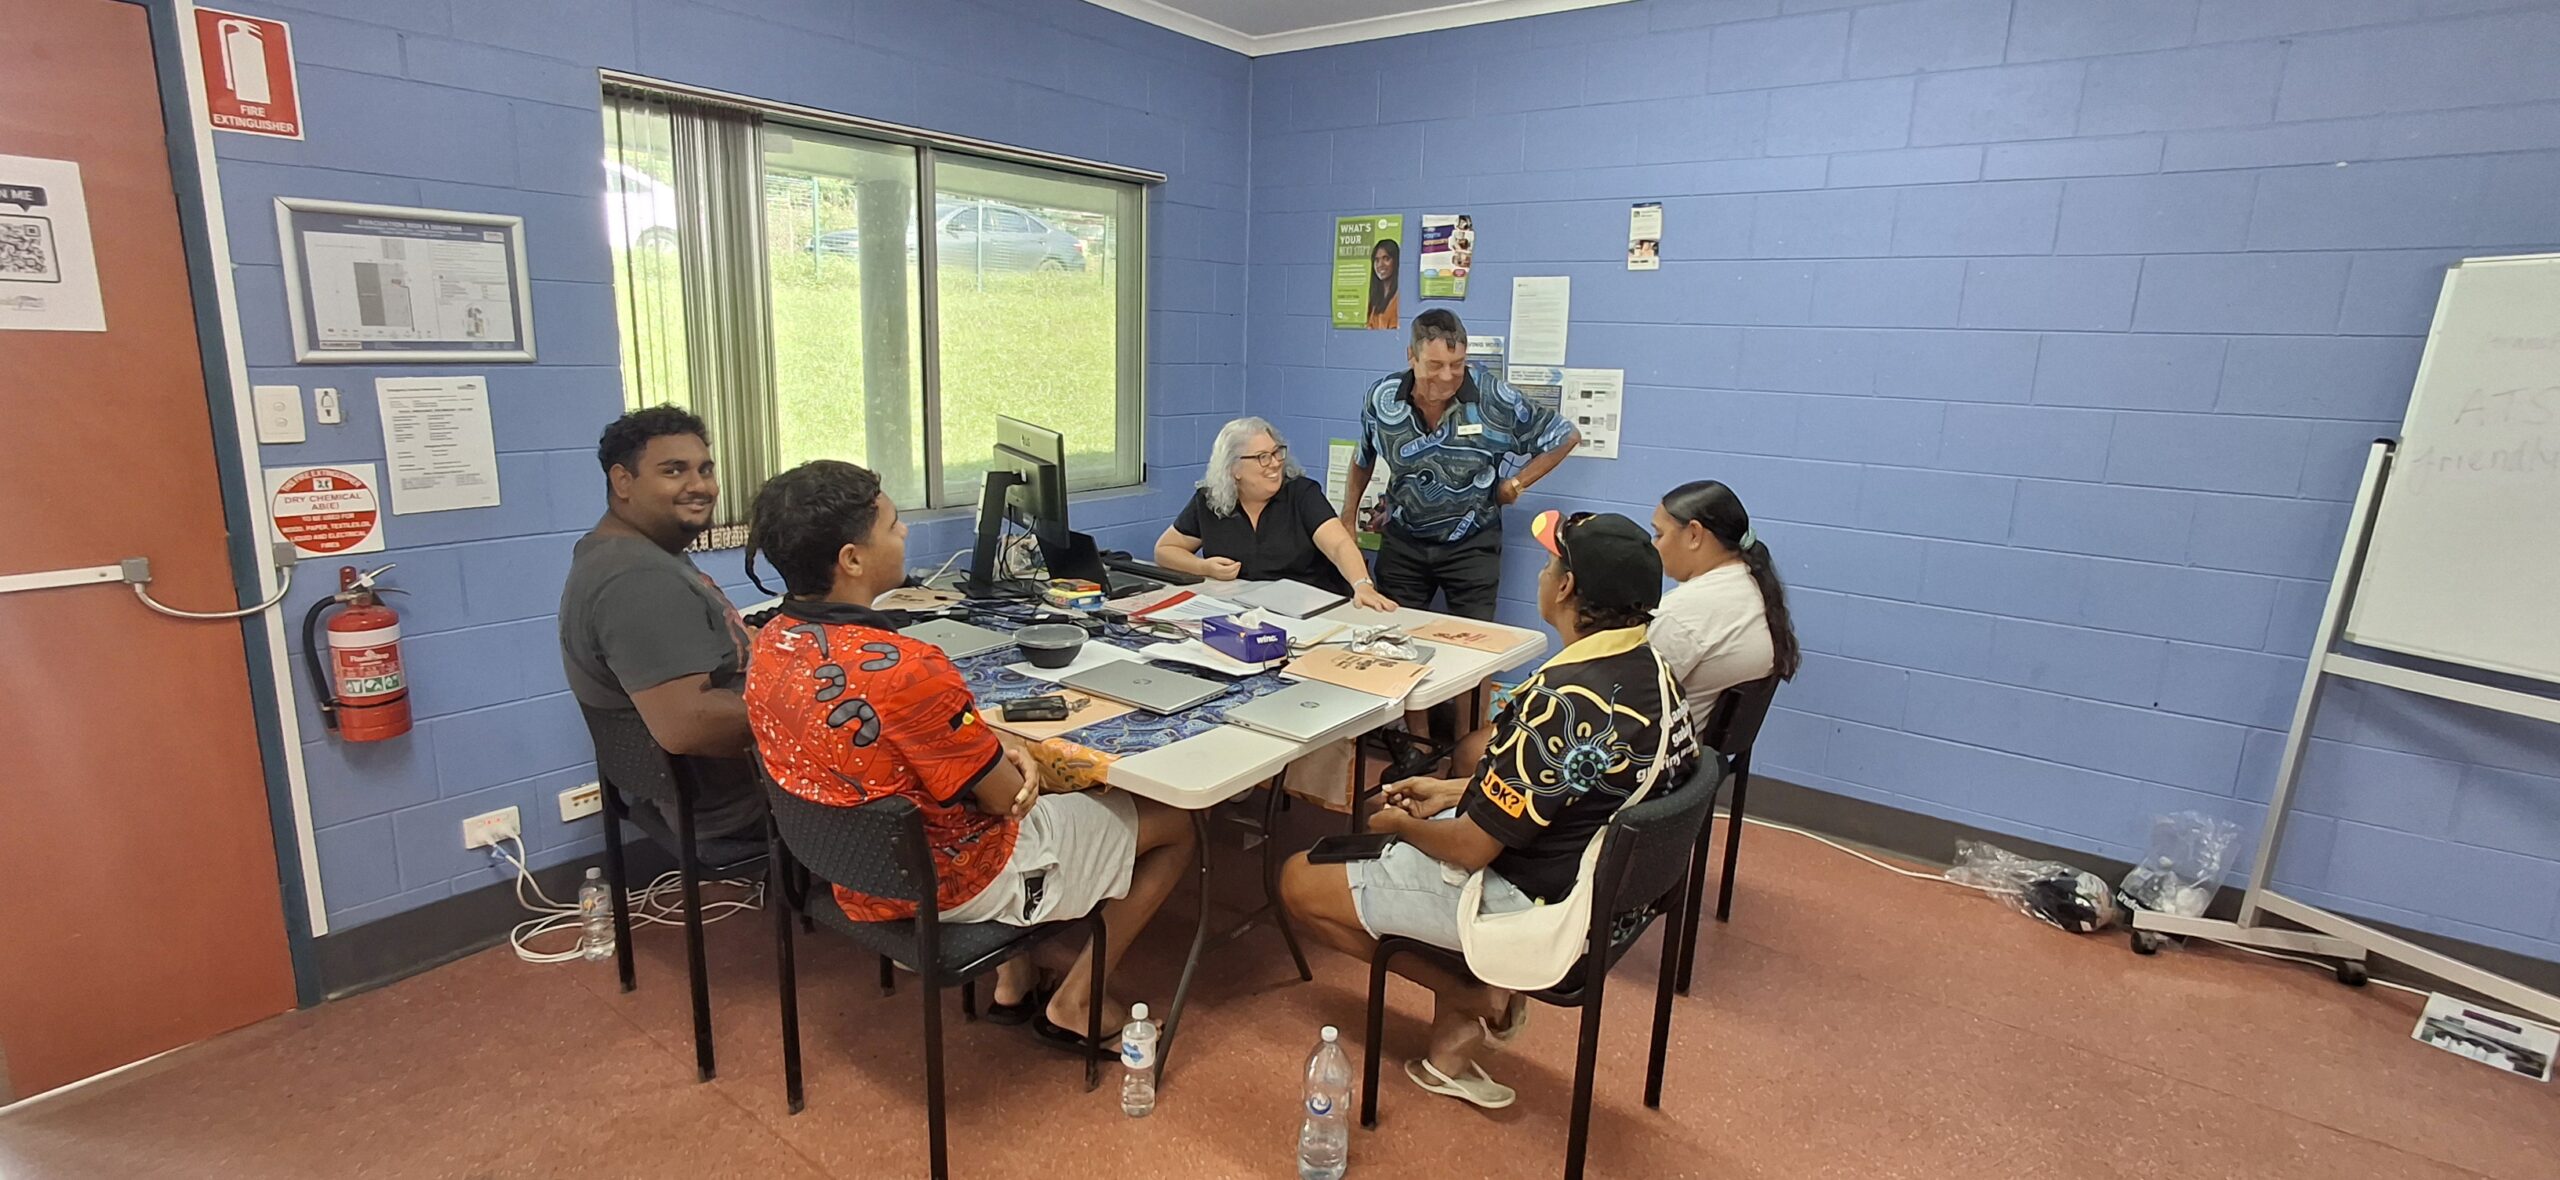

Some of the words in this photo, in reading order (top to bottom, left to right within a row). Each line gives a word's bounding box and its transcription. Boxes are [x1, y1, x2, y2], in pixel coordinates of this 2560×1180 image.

[240, 104, 266, 117] FIRE
[212, 113, 295, 133] EXTINGUISHER
[11, 190, 33, 201] ME
[1340, 223, 1372, 233] WHAT'S
[1340, 235, 1362, 245] YOUR
[284, 496, 305, 504] DRY
[309, 493, 362, 502] CHEMICAL
[312, 502, 339, 511] AB(E)
